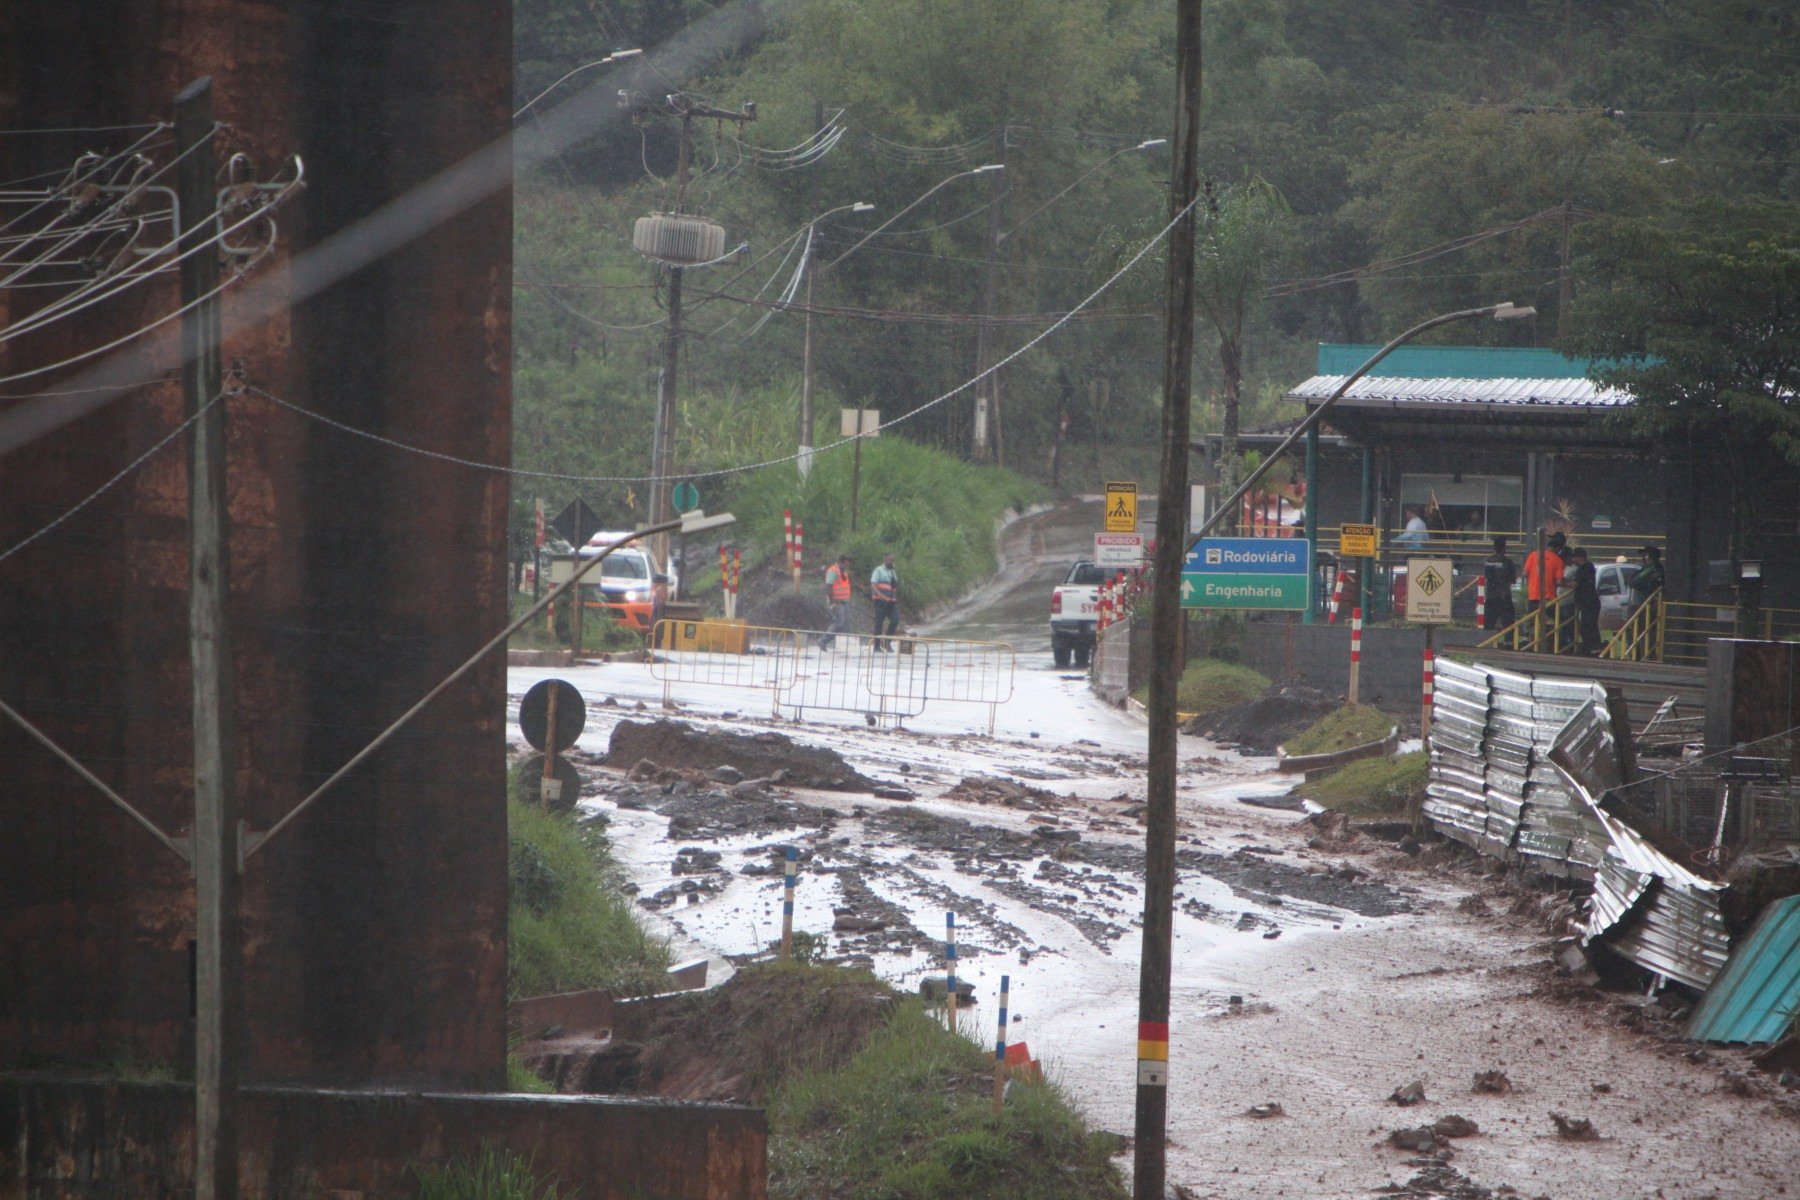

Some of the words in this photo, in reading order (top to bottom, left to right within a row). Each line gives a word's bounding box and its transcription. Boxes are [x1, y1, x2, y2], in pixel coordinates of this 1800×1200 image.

[1345, 527, 1372, 535] ATENÇÃO
[1101, 537, 1137, 545] PROIBIDO
[1224, 550, 1296, 563] Rodoviária
[1206, 583, 1282, 599] Engenharia
